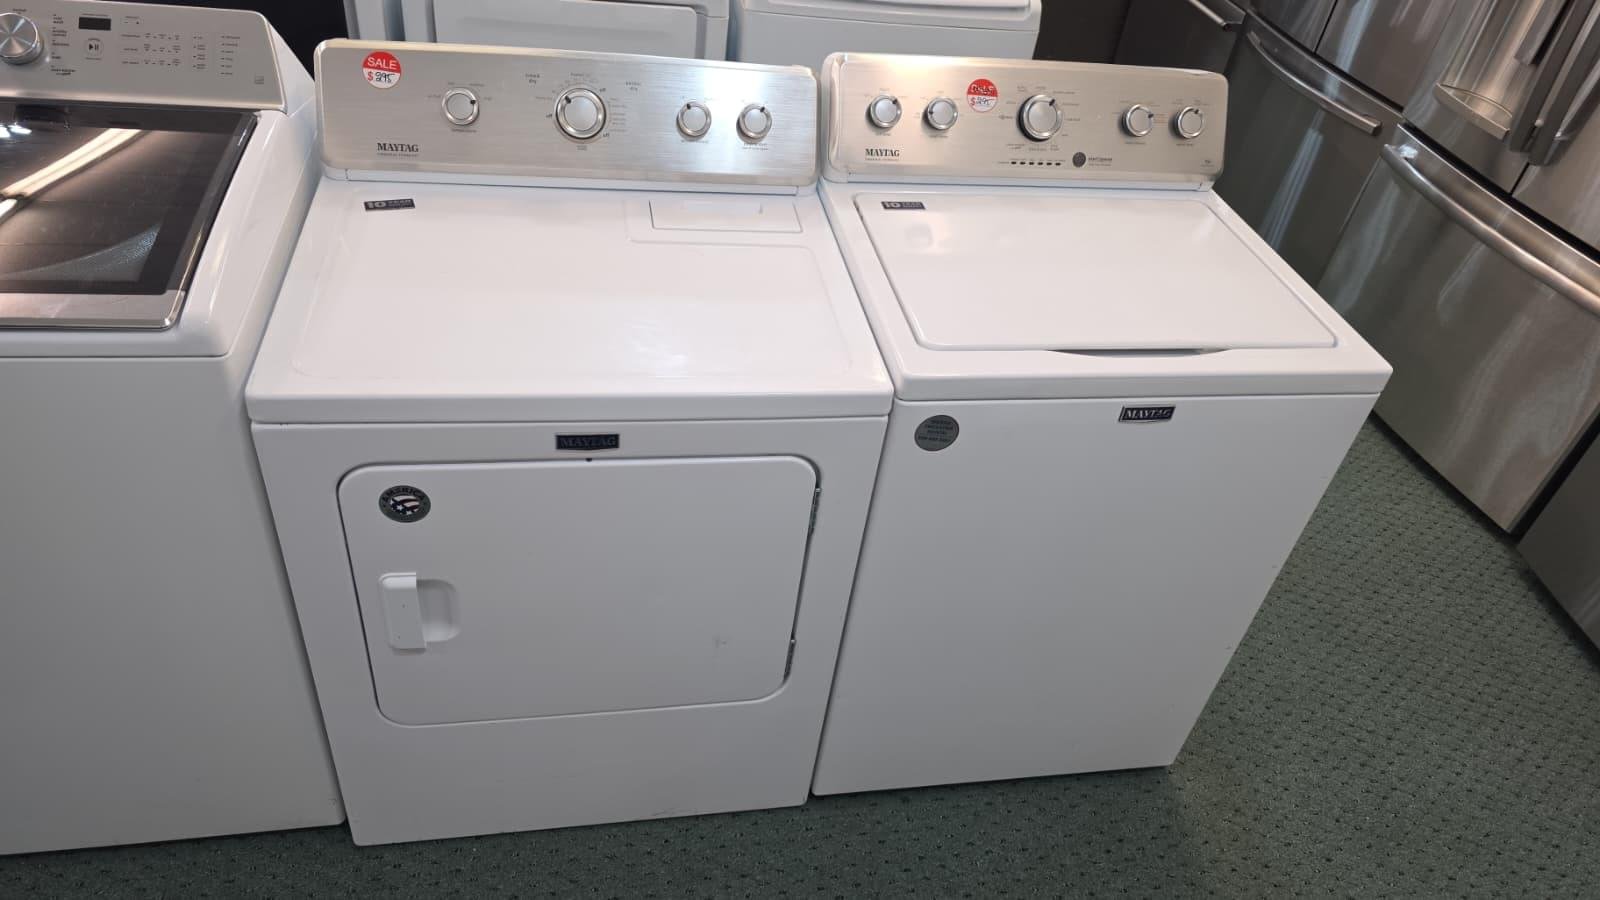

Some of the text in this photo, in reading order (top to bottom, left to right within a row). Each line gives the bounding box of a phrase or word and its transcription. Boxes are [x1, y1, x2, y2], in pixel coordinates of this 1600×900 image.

[367, 57, 397, 70] SALE
[377, 142, 419, 153] MAYTAG
[865, 148, 900, 157] MAYTAG
[367, 201, 386, 209] 10
[1123, 409, 1170, 418] MAYTAG
[560, 436, 616, 448] MAYTAG
